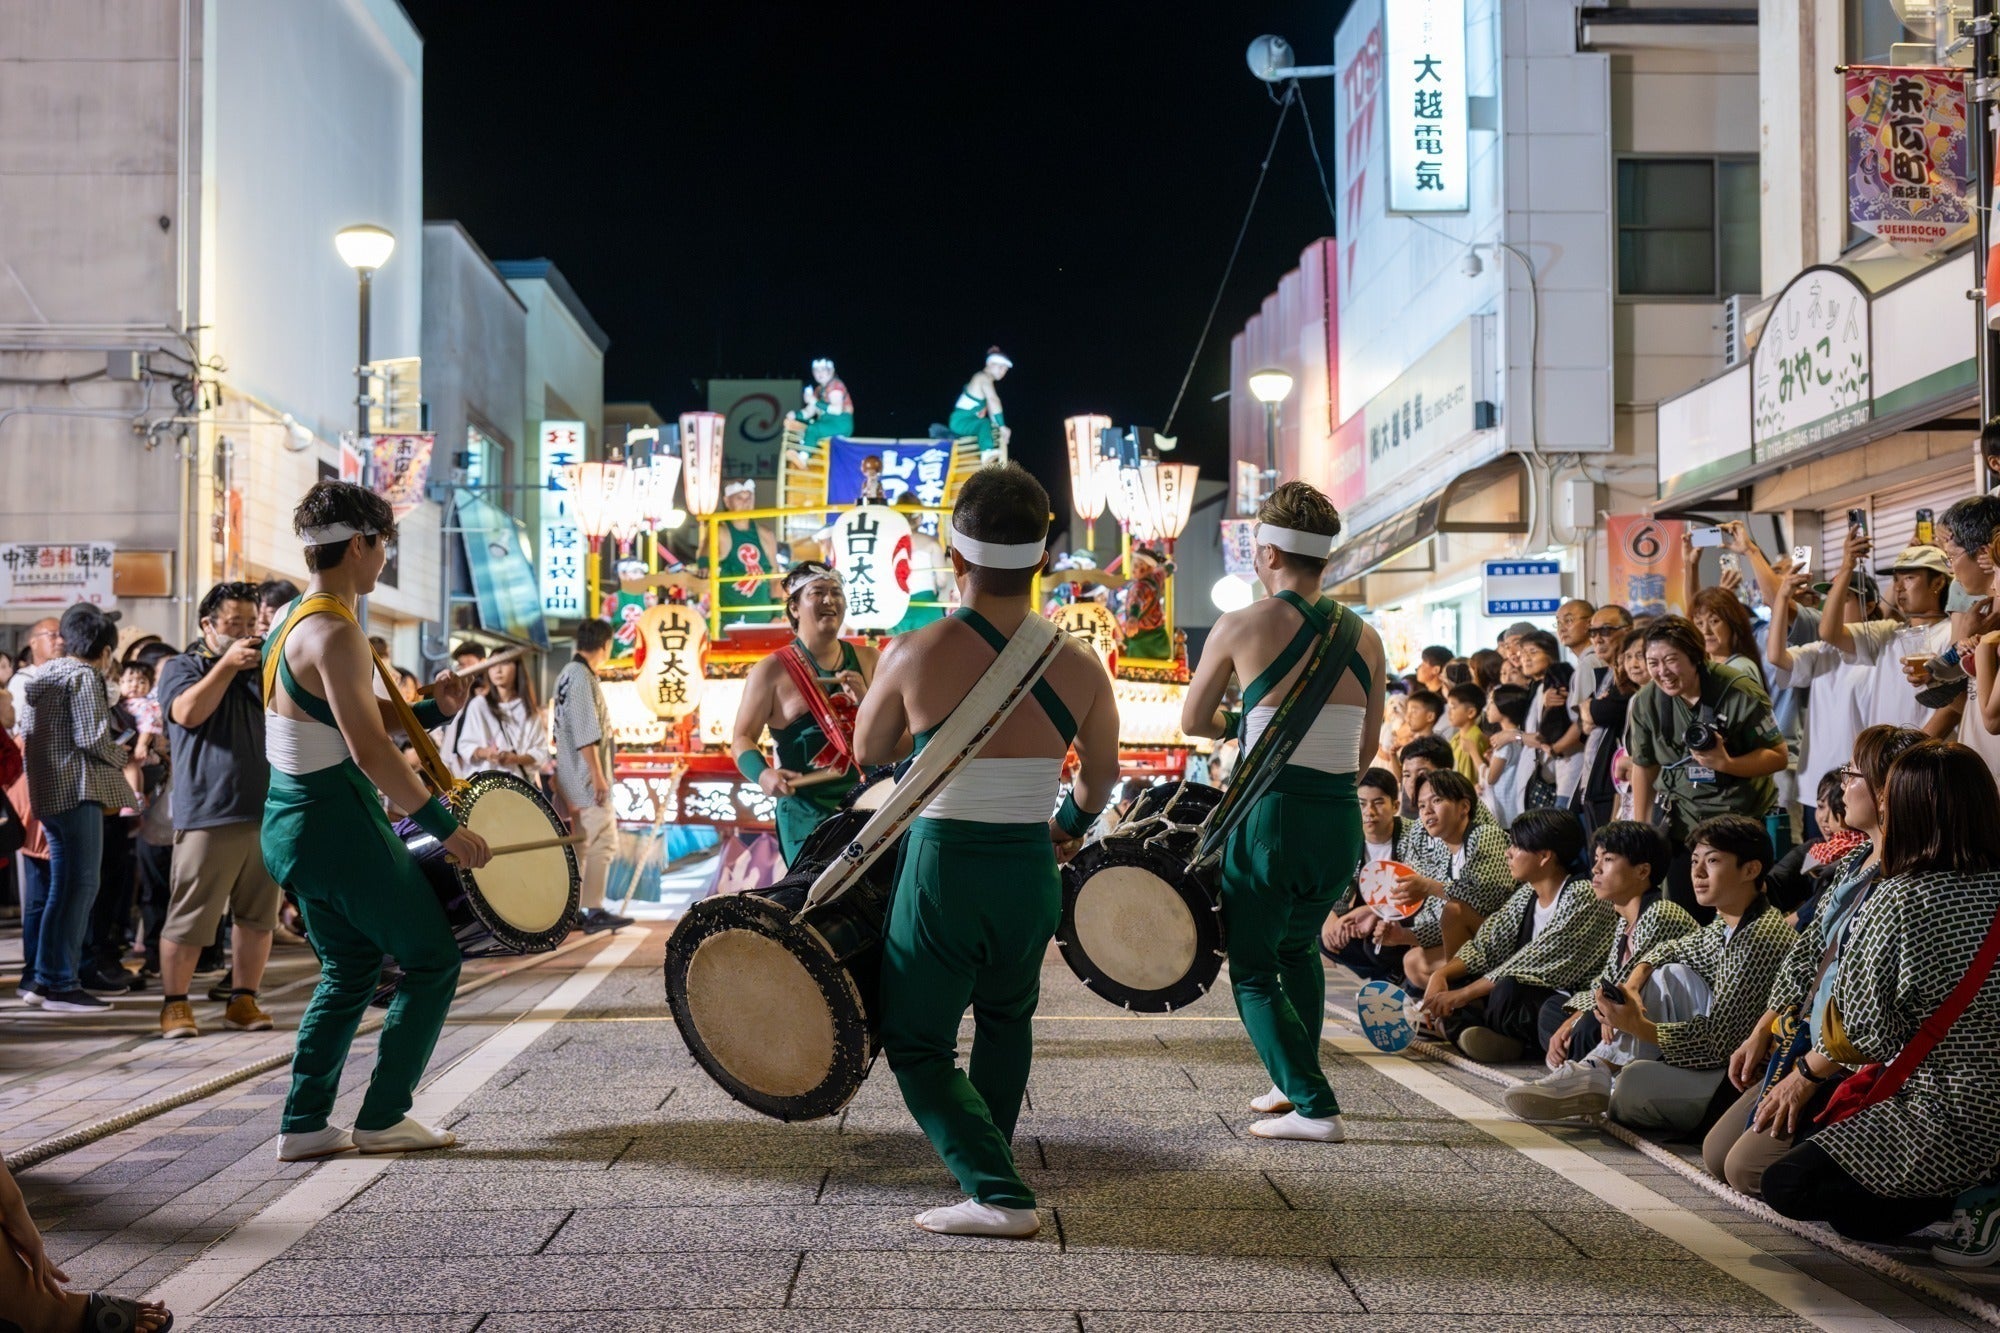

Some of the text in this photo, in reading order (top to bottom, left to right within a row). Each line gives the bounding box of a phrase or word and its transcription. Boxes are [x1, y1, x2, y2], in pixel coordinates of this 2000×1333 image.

[1413, 54, 1444, 191] 大越電気
[1890, 77, 1927, 184] 末広町
[1877, 224, 1947, 237] SUEHIROCHO
[1889, 236, 1918, 244] Shopping
[1779, 336, 1833, 404] みやこ
[2, 547, 112, 571] 中澤歯科医院
[846, 512, 879, 616] 山口太鼓
[1632, 526, 1660, 558] 6
[657, 612, 691, 704] 山口太鼓
